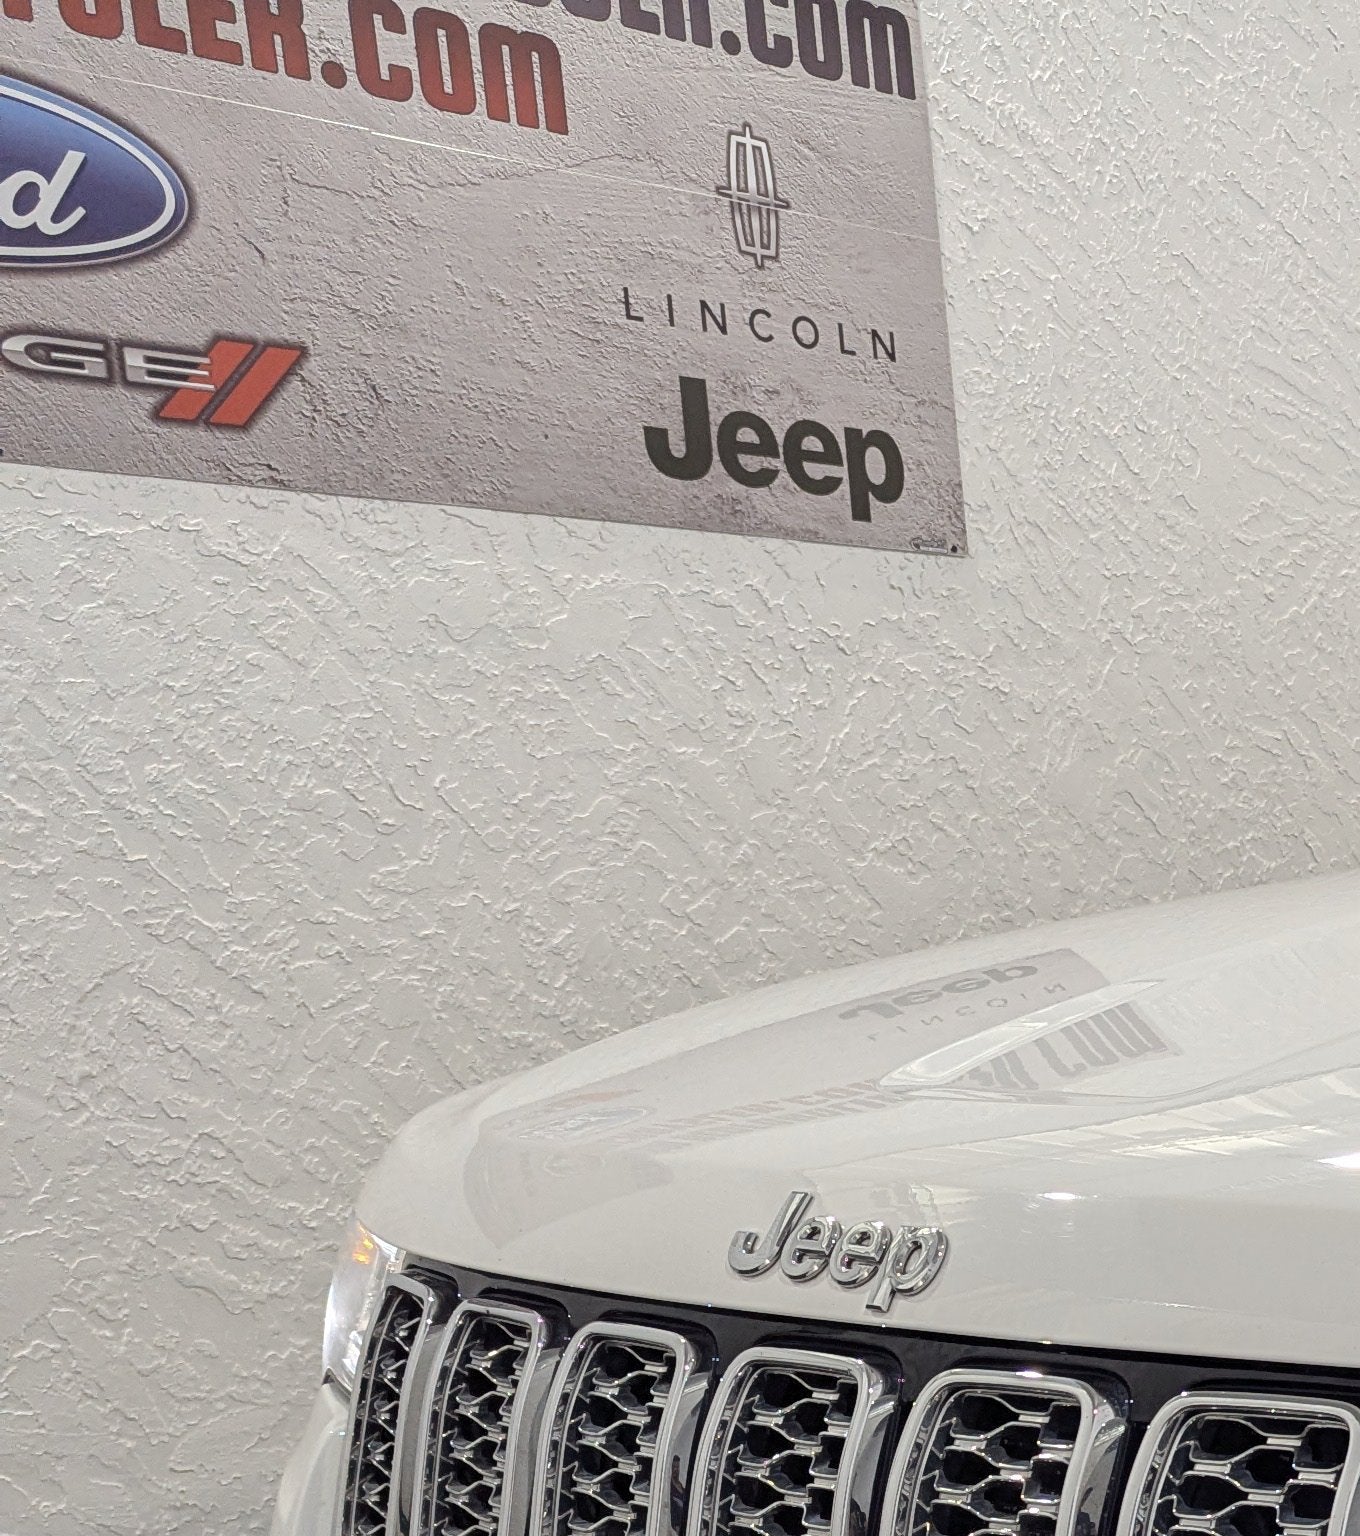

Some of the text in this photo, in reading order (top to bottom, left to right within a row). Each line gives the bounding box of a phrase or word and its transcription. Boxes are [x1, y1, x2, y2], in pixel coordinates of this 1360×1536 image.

[623, 286, 897, 363] LINCOLN
[643, 375, 905, 523] Jeep
[727, 1190, 949, 1313] Jeep
